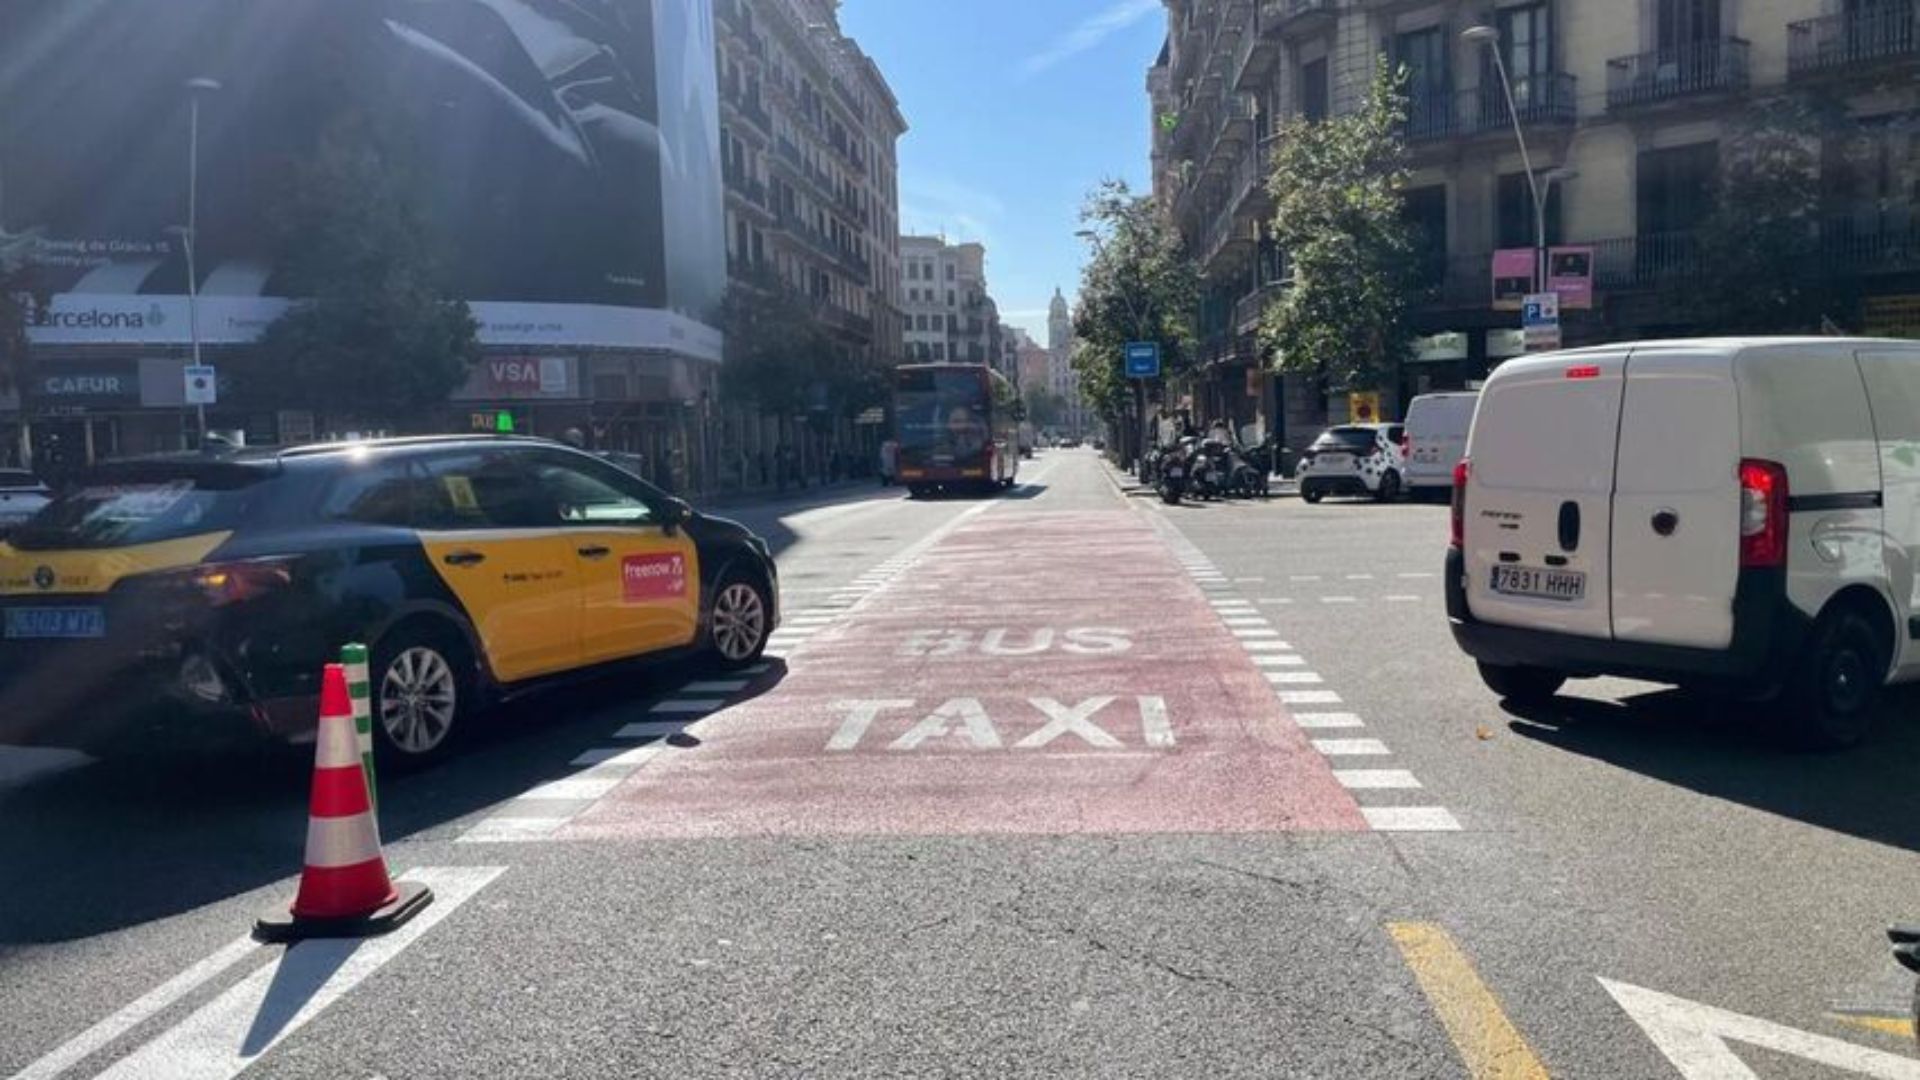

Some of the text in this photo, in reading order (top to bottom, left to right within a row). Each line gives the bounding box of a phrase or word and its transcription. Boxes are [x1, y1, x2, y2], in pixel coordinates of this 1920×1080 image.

[1528, 305, 1537, 319] P
[1500, 569, 1540, 591] 7831
[898, 627, 1134, 655] BUS
[825, 695, 1176, 751] TAXI
